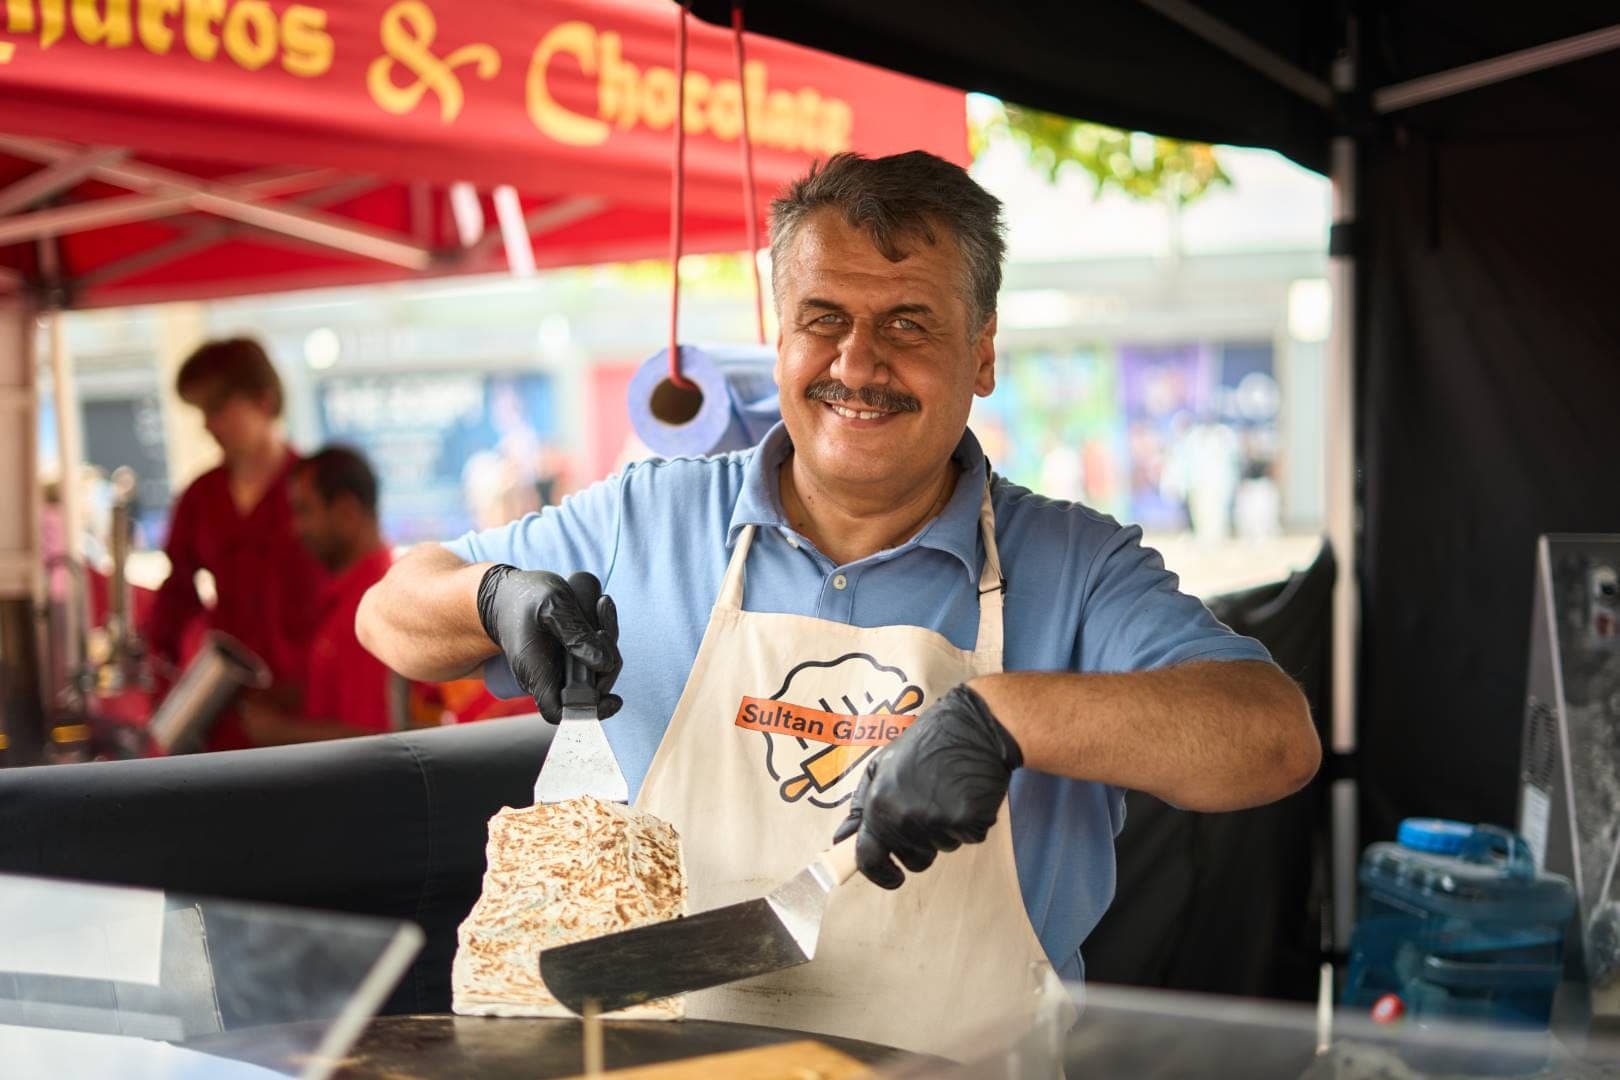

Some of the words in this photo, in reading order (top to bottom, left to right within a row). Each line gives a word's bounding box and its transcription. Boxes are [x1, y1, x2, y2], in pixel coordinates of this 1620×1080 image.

[366, 0, 501, 126] &
[742, 703, 824, 736] Sultan
[833, 718, 908, 741] Gozle
